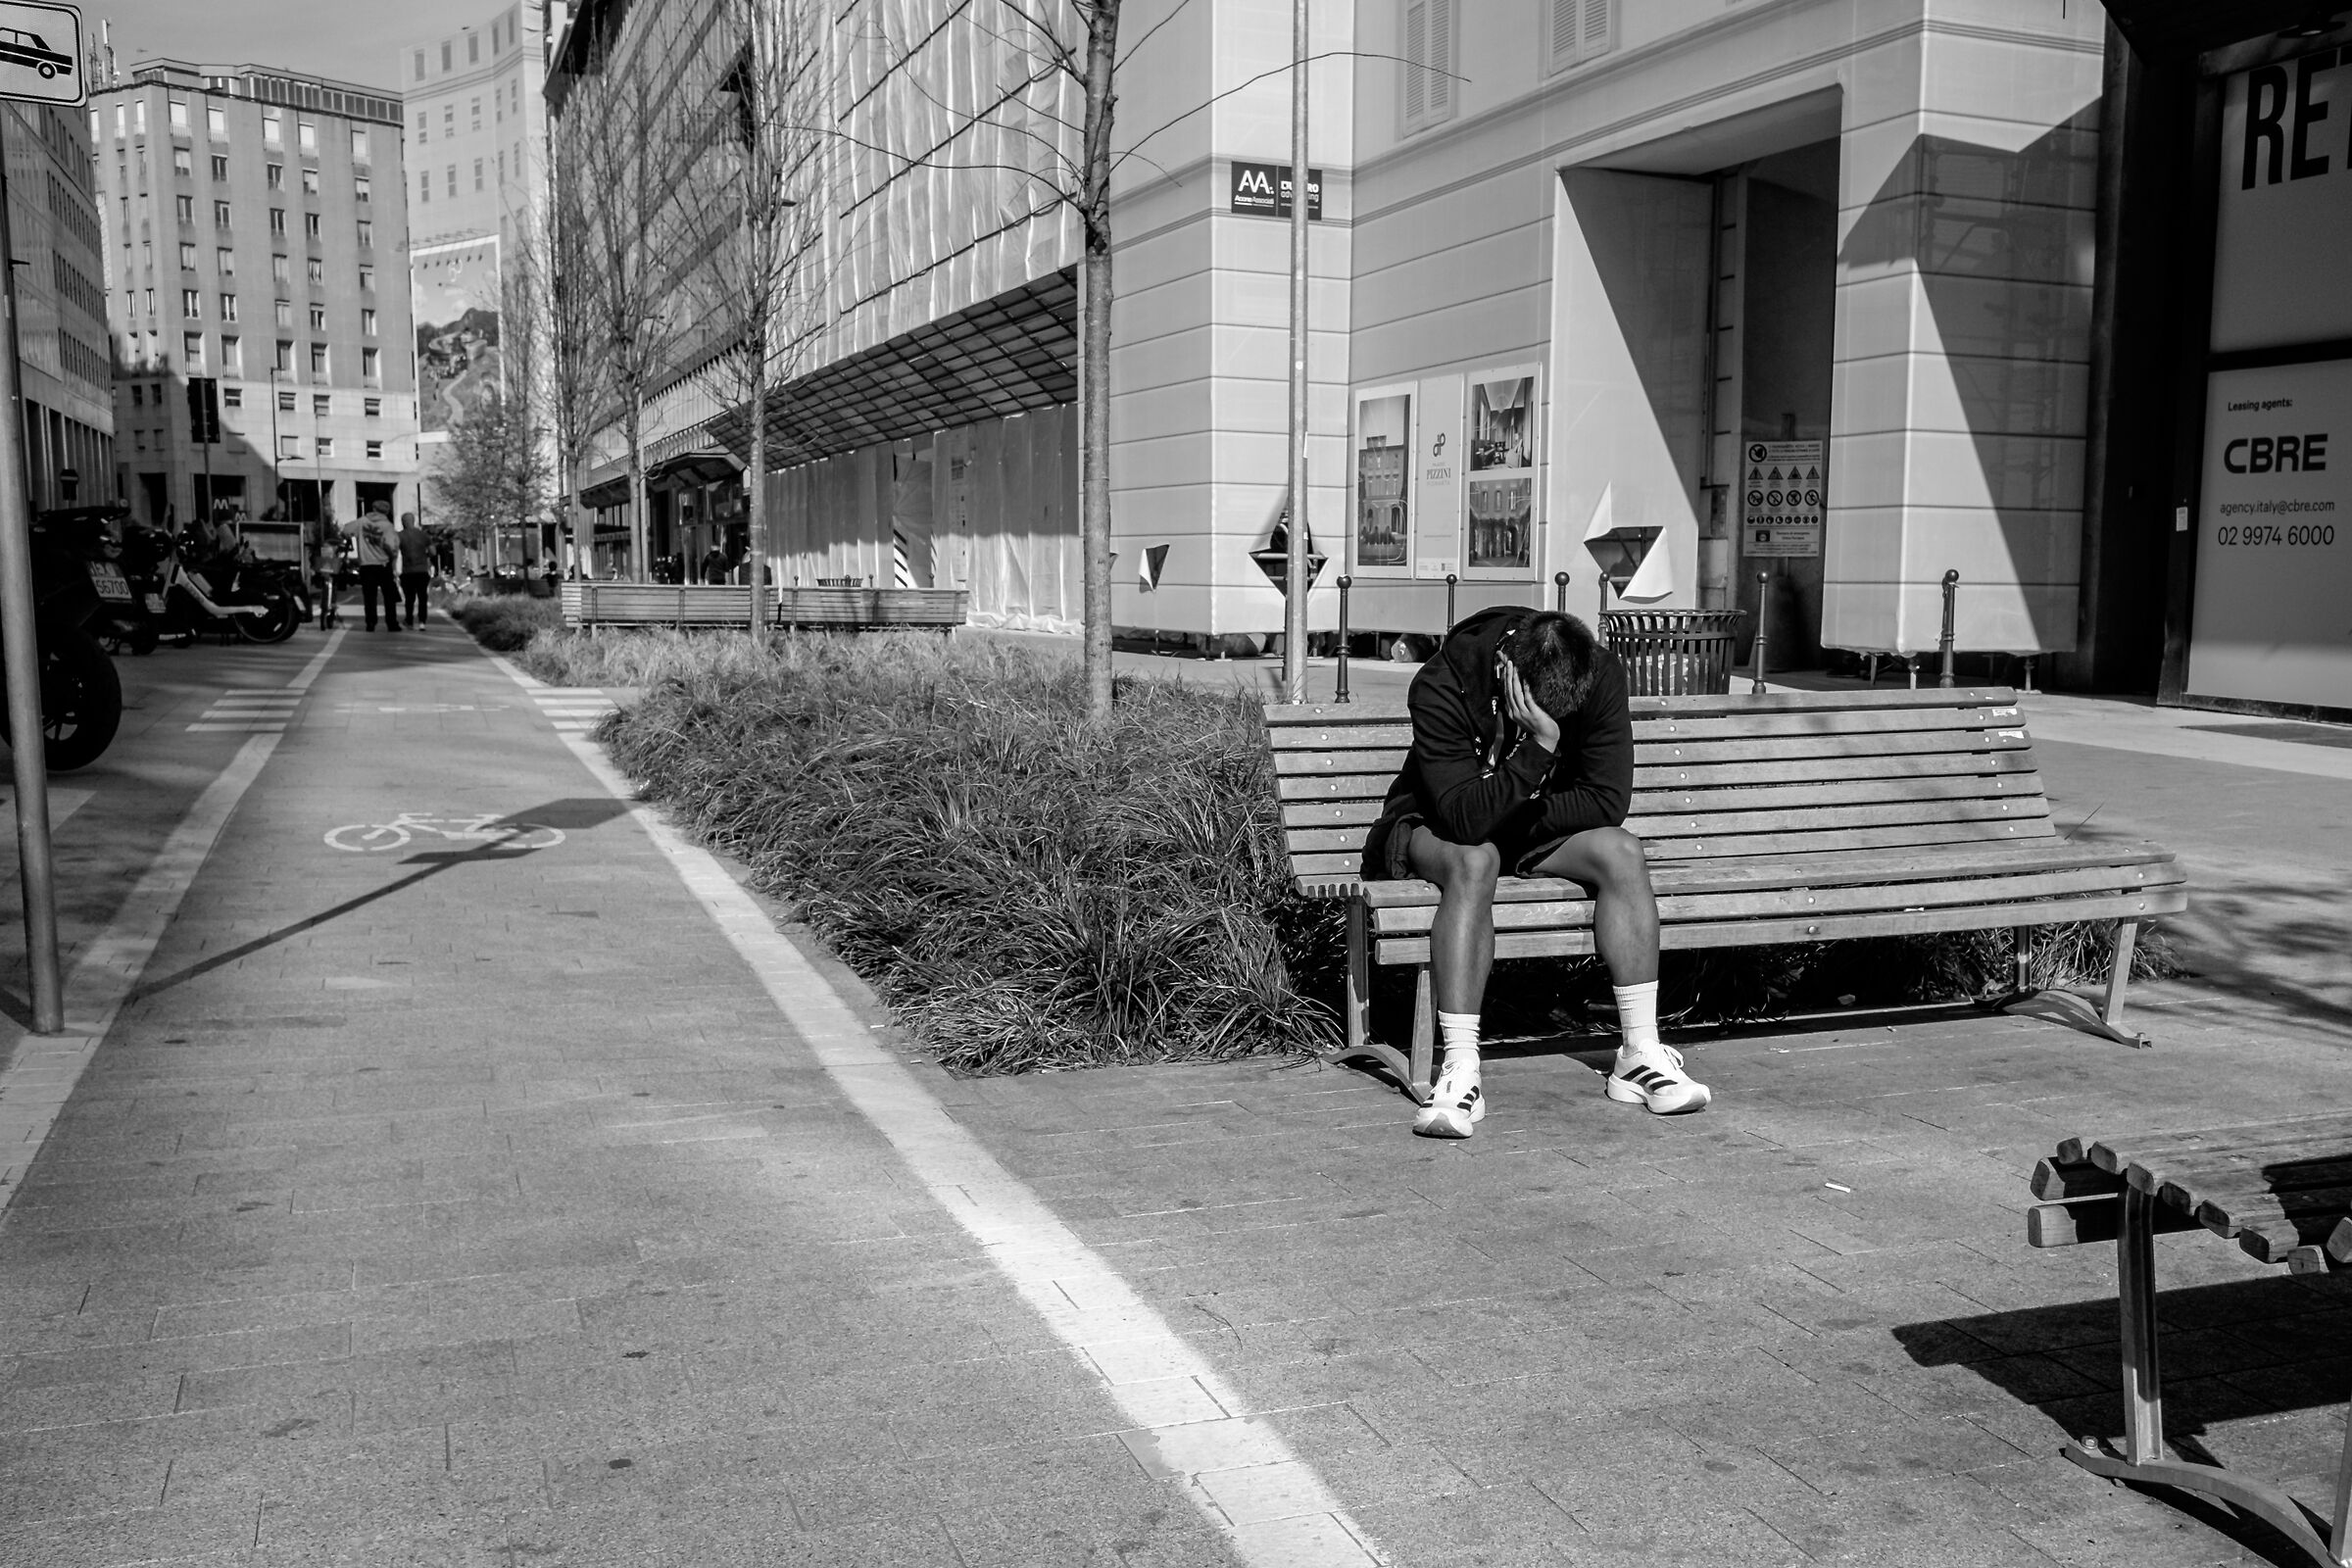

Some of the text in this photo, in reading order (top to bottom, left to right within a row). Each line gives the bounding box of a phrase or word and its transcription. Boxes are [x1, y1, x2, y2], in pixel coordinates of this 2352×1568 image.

[2228, 398, 2293, 412] Leasing agents:
[2224, 433, 2328, 474] CBRE
[1426, 467, 1451, 480] PIZZINI
[213, 498, 228, 511] M
[2220, 499, 2335, 516] agency.italy@cbre.com
[2218, 524, 2334, 546] 02 9974 6000
